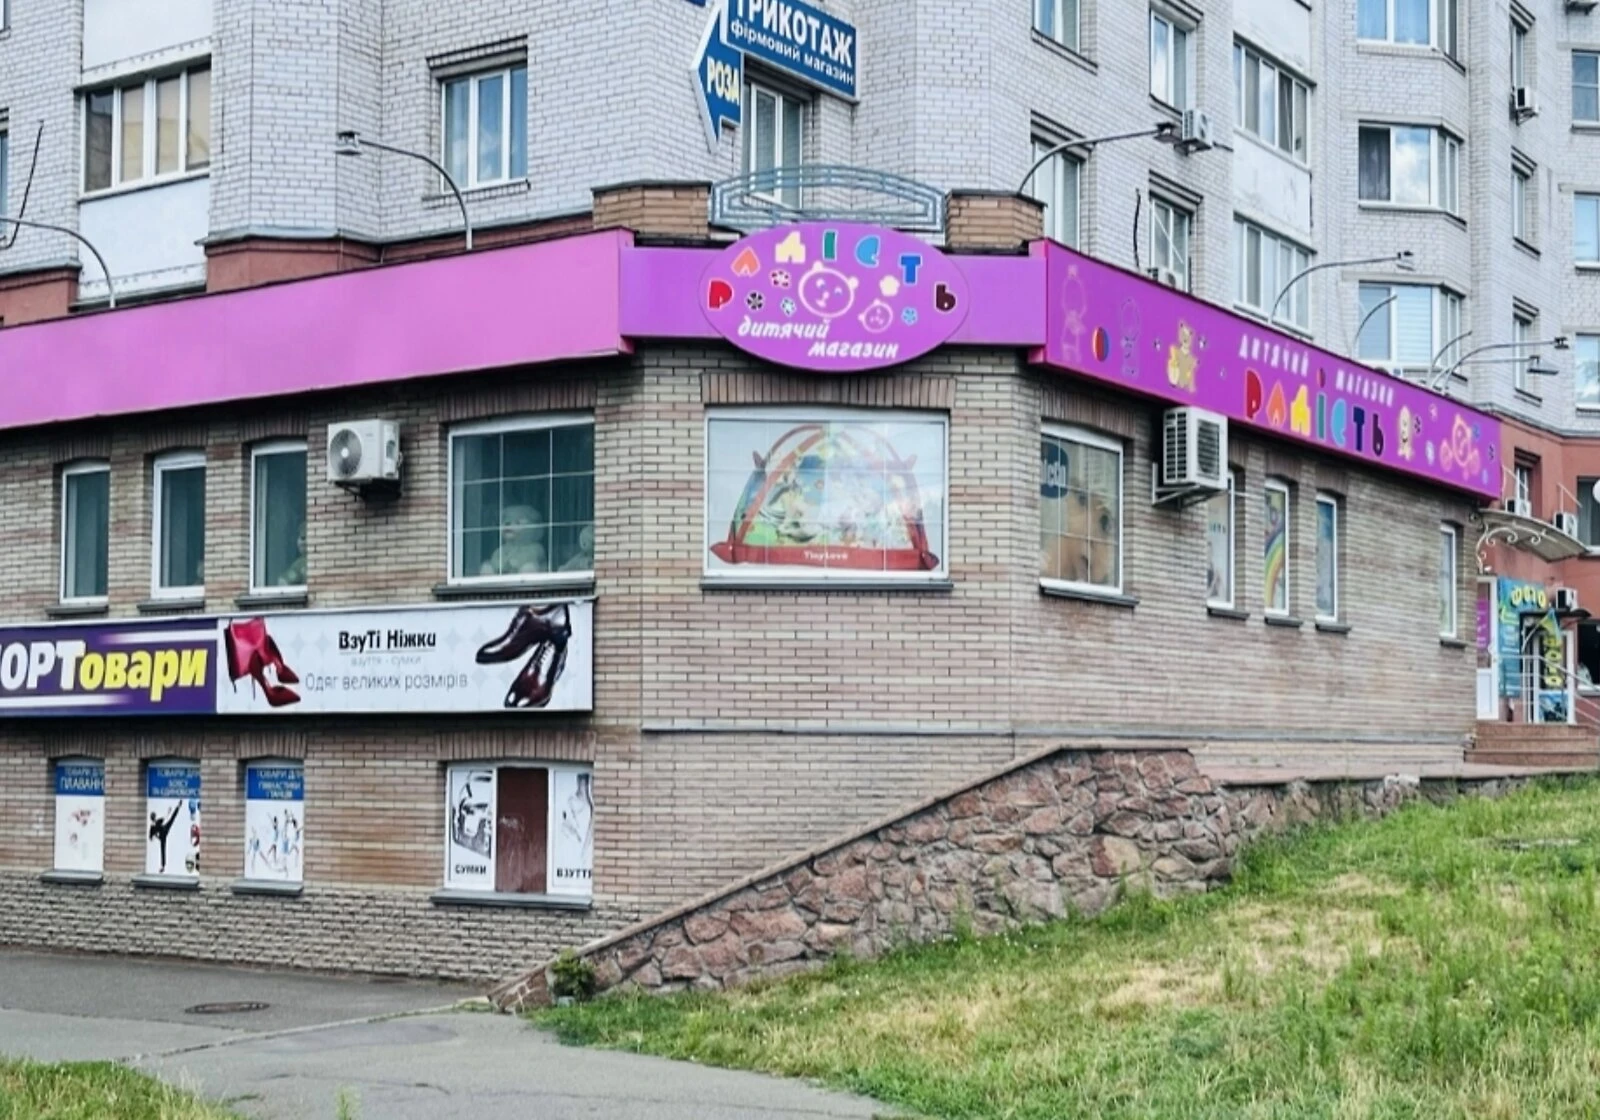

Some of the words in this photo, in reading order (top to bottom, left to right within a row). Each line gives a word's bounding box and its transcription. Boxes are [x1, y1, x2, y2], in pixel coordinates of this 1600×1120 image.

[731, 19, 800, 62] фірмовий
[804, 53, 854, 85] магазин
[706, 56, 740, 106] РОЗА
[737, 316, 830, 339] дитячий
[807, 341, 899, 359] магазин
[1238, 334, 1310, 377] ДИТЯЧИЙ
[1335, 369, 1394, 407] МАГАЗИН
[387, 629, 437, 649] Ніжки
[0, 640, 208, 702] ОРТовари
[305, 672, 337, 691] Одяг
[342, 674, 401, 690] великих
[405, 672, 468, 692] розмірів
